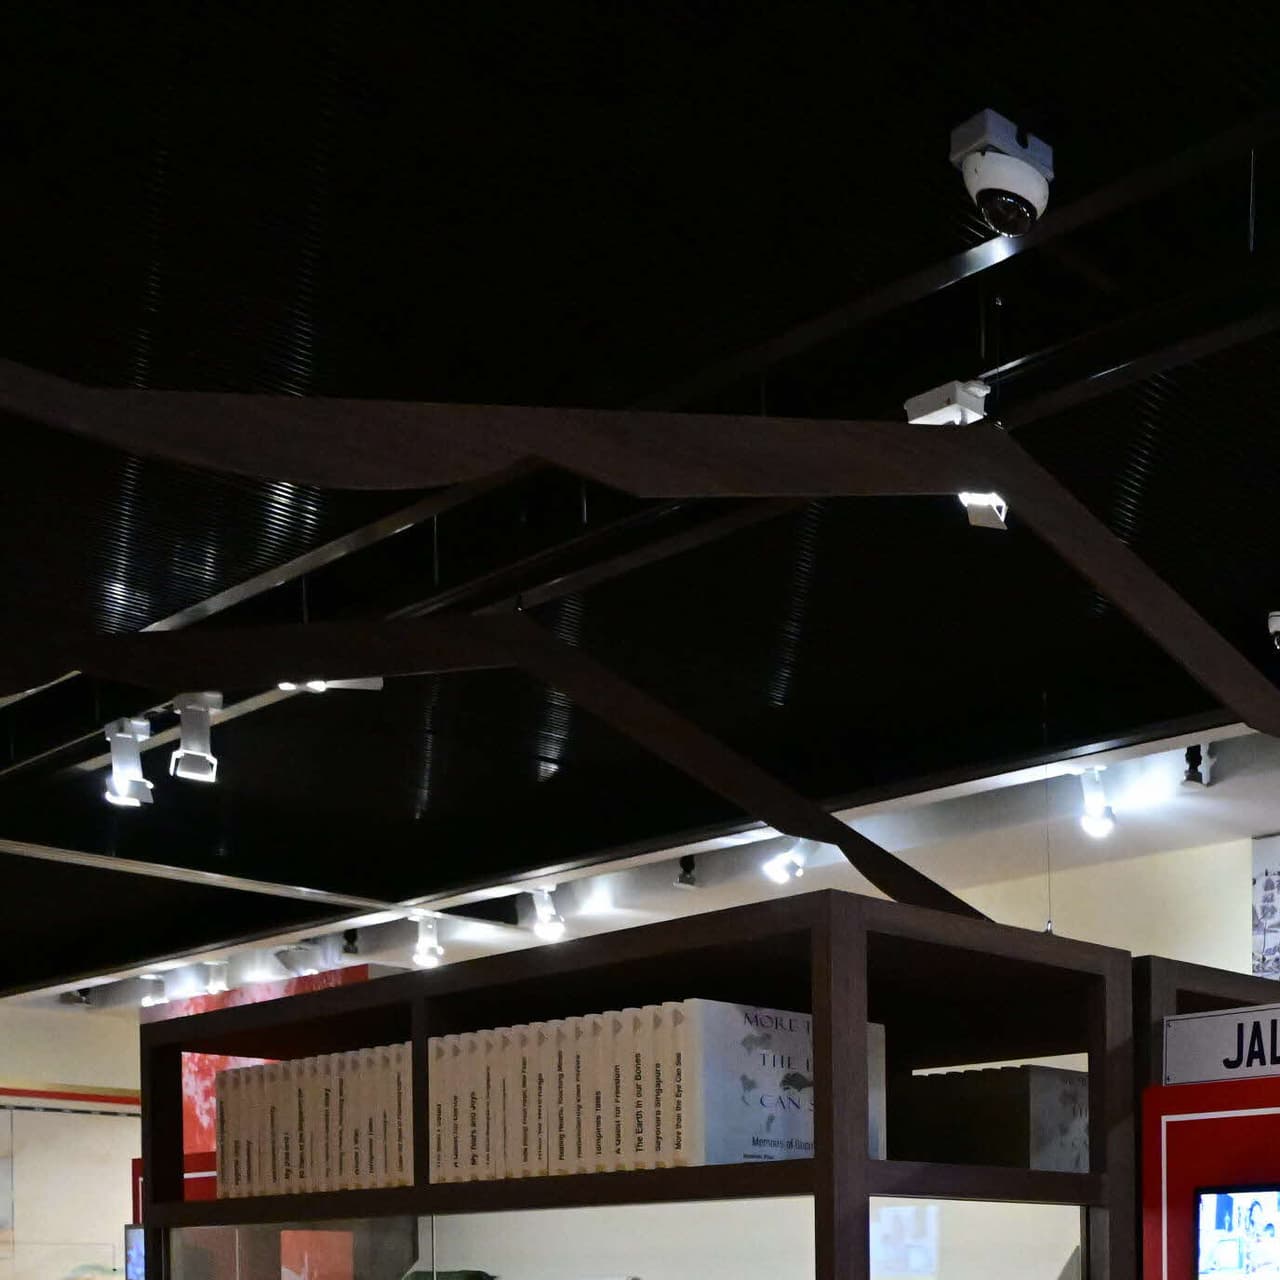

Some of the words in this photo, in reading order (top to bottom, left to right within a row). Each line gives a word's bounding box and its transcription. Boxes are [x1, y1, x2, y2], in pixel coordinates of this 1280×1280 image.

[634, 1053, 642, 1081] Bones
[635, 1110, 644, 1134] Earth
[635, 1136, 644, 1153] The
